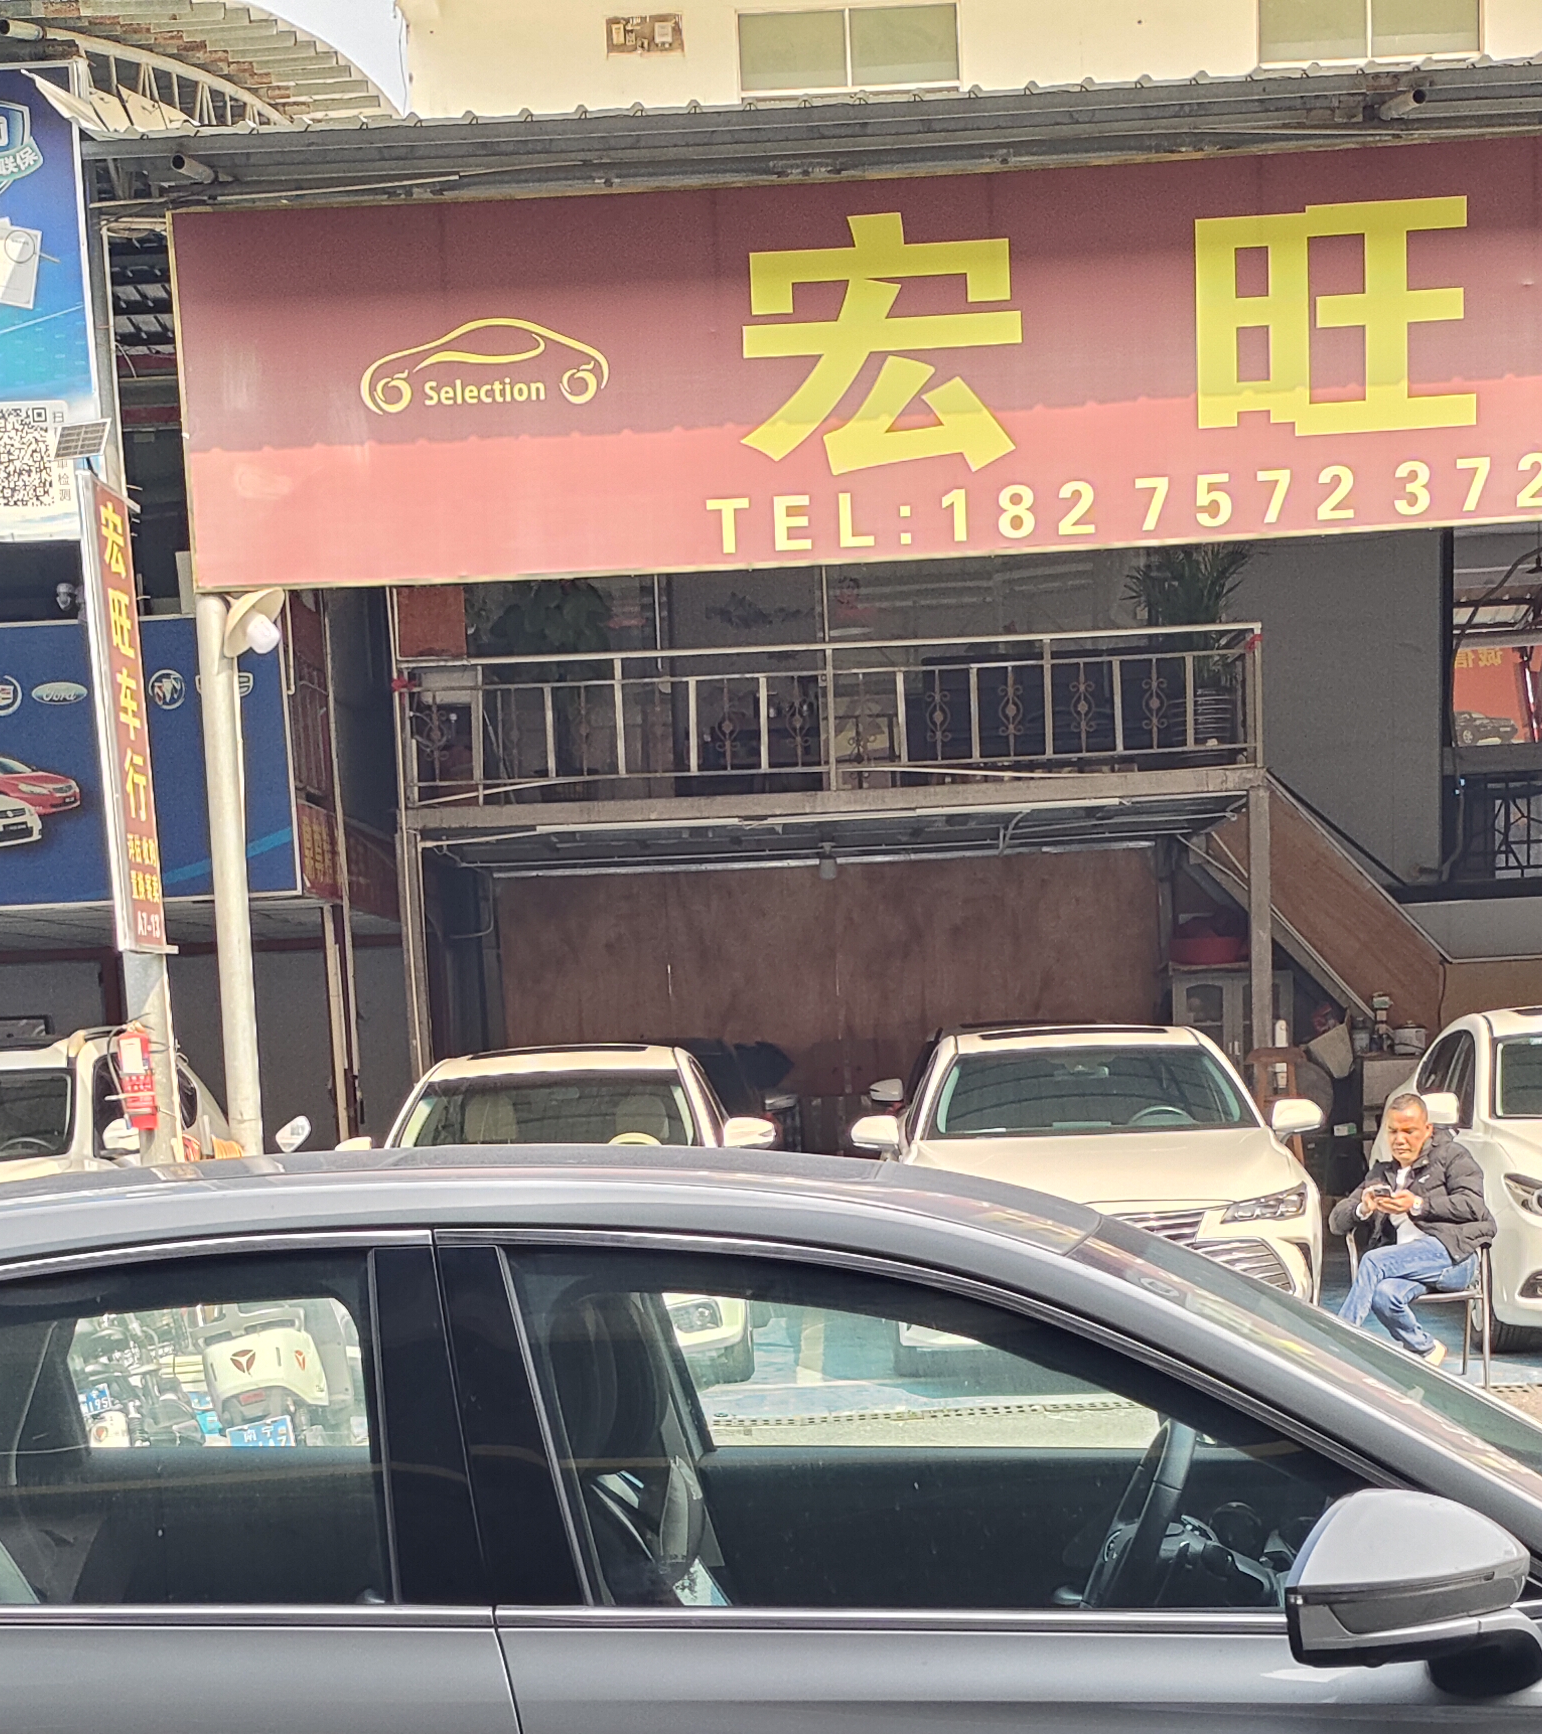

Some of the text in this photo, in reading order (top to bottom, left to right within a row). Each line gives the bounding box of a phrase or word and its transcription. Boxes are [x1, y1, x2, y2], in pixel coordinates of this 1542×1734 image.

[423, 376, 547, 405] Selection
[99, 500, 148, 824] 宏旺车行
